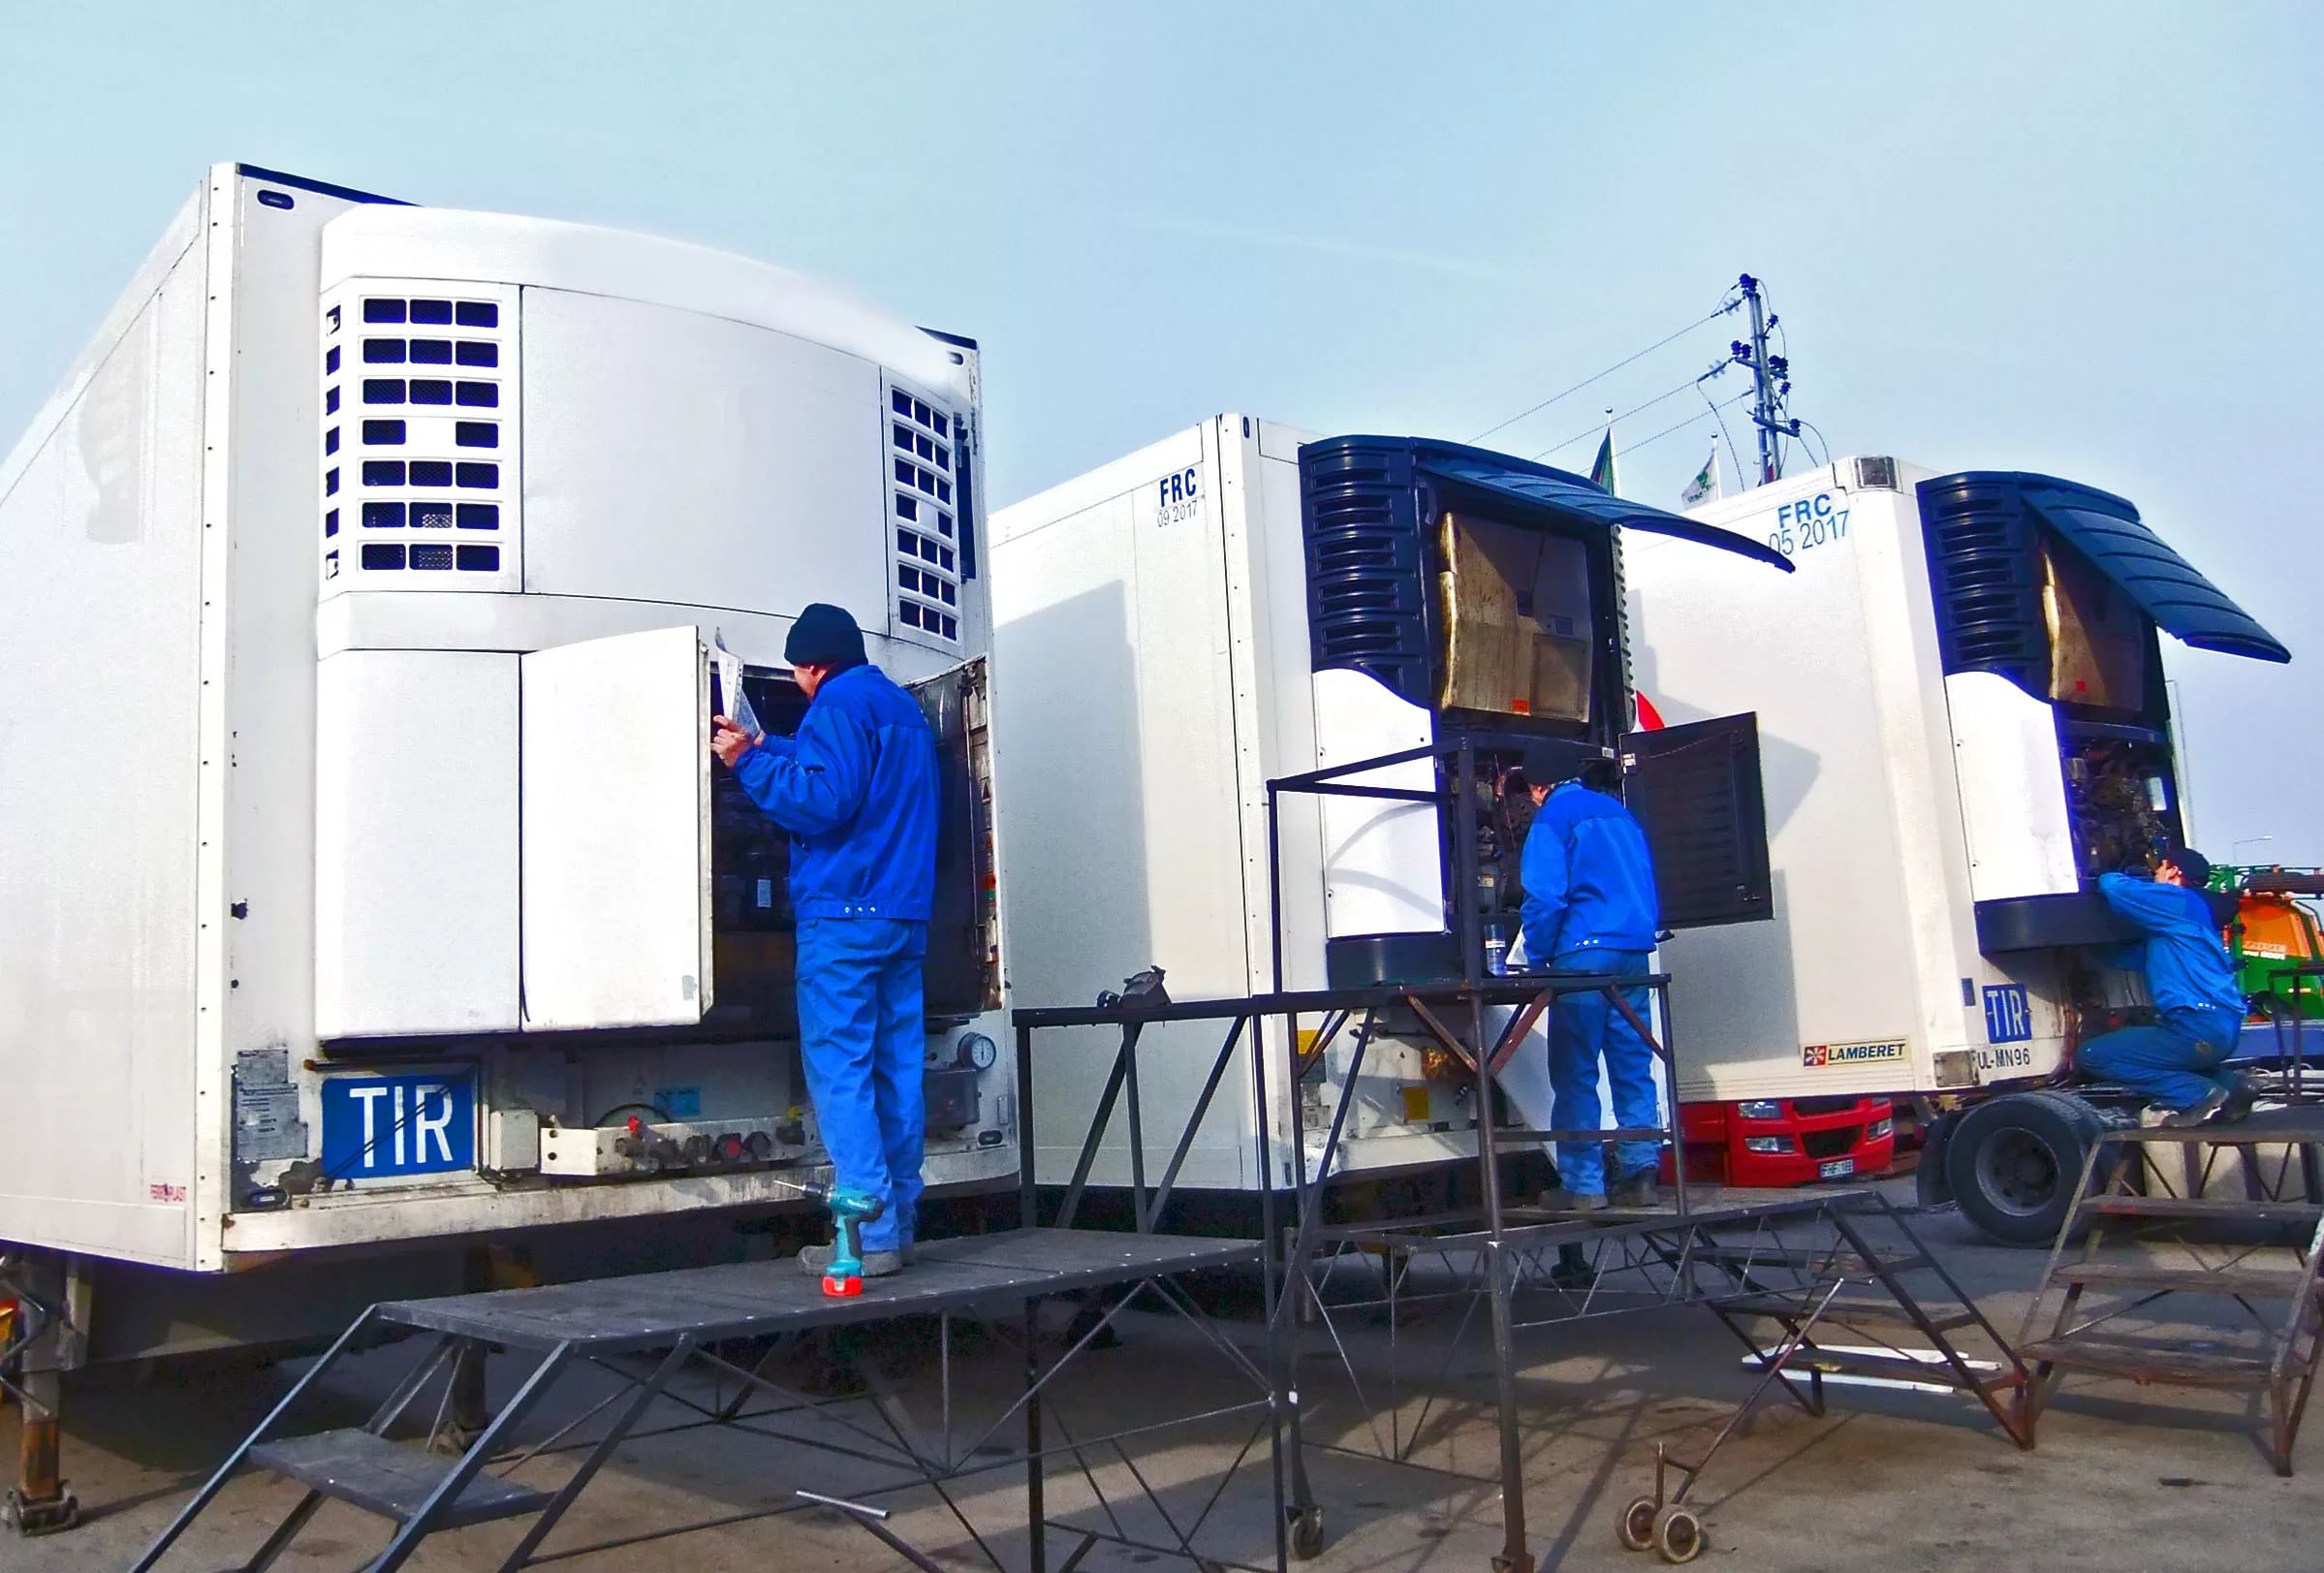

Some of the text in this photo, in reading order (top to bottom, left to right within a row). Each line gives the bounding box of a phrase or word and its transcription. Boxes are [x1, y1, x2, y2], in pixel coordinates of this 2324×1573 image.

[1159, 468, 1197, 508] FRC
[1156, 499, 1198, 528] 09 2017
[1777, 493, 1832, 529] FRC
[1769, 510, 1850, 555] 05 2017
[1987, 990, 2026, 1038] TIR
[1828, 1043, 1906, 1061] LAMBERET
[349, 1085, 454, 1168] TIR
